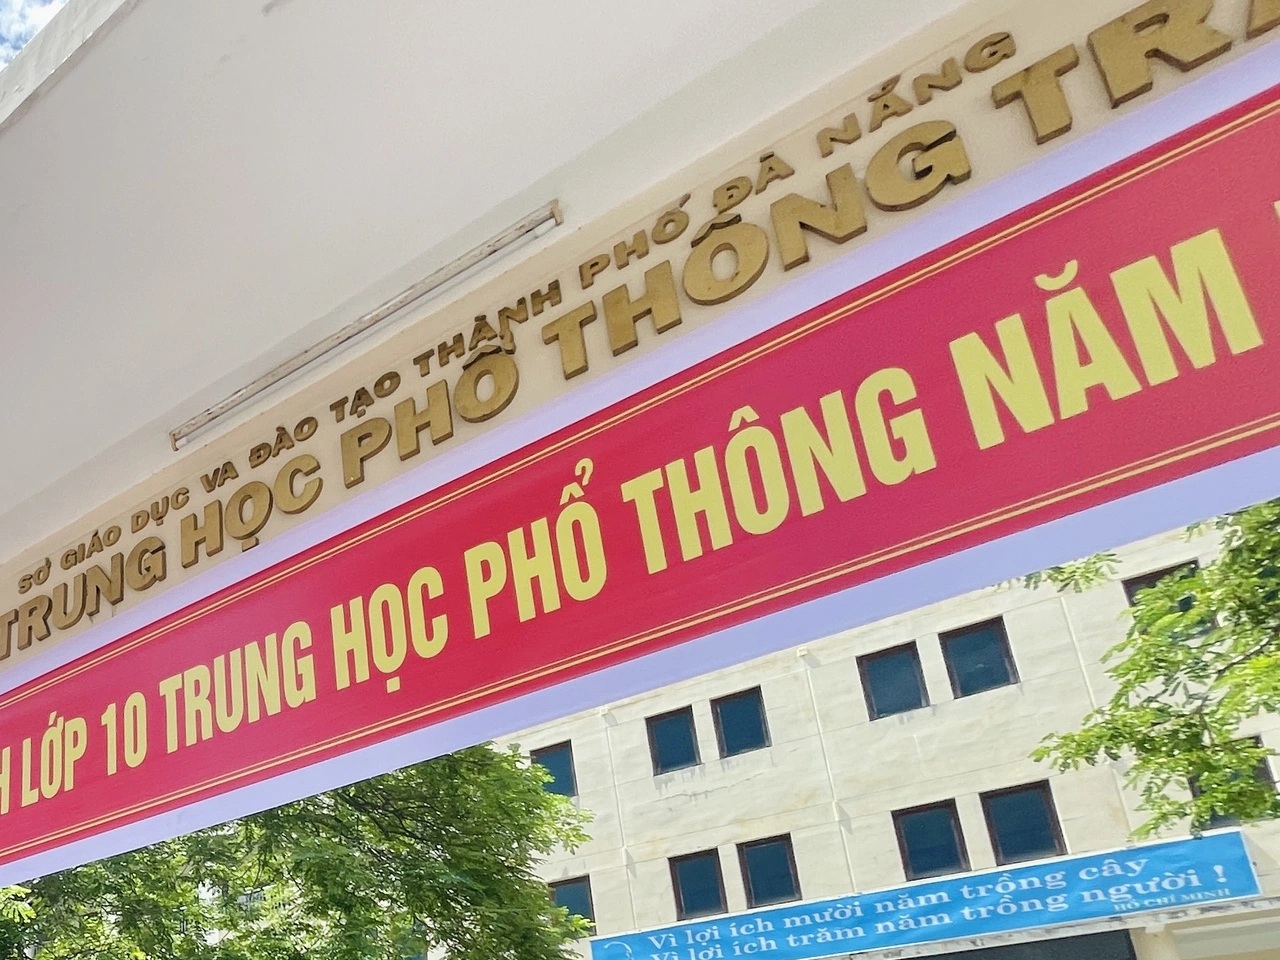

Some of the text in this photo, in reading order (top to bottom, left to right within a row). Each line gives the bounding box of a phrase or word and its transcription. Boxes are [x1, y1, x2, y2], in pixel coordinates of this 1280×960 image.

[22, 710, 87, 808] LỚP
[101, 692, 148, 776] 10
[159, 621, 316, 754] TRUNG
[330, 565, 448, 694] HỌC
[464, 458, 607, 640] PHỔ
[621, 368, 937, 575] THÔNG
[949, 228, 1264, 450] NĂM
[60, 530, 121, 570] GIÁO
[131, 487, 190, 533] DỤC
[249, 416, 318, 468] ĐÀO
[330, 371, 401, 423] TẠO
[579, 193, 691, 289] PHỐ
[180, 454, 324, 570] HỌC
[542, 120, 972, 379] THÔNG
[648, 859, 1150, 949] Vì lợi ích mười năm trồng cây
[733, 937, 778, 956] ích
[786, 926, 866, 947] trăm
[875, 912, 952, 934] năm
[961, 894, 1069, 921] trồng
[1081, 869, 1202, 903] người
[1213, 865, 1227, 883] !
